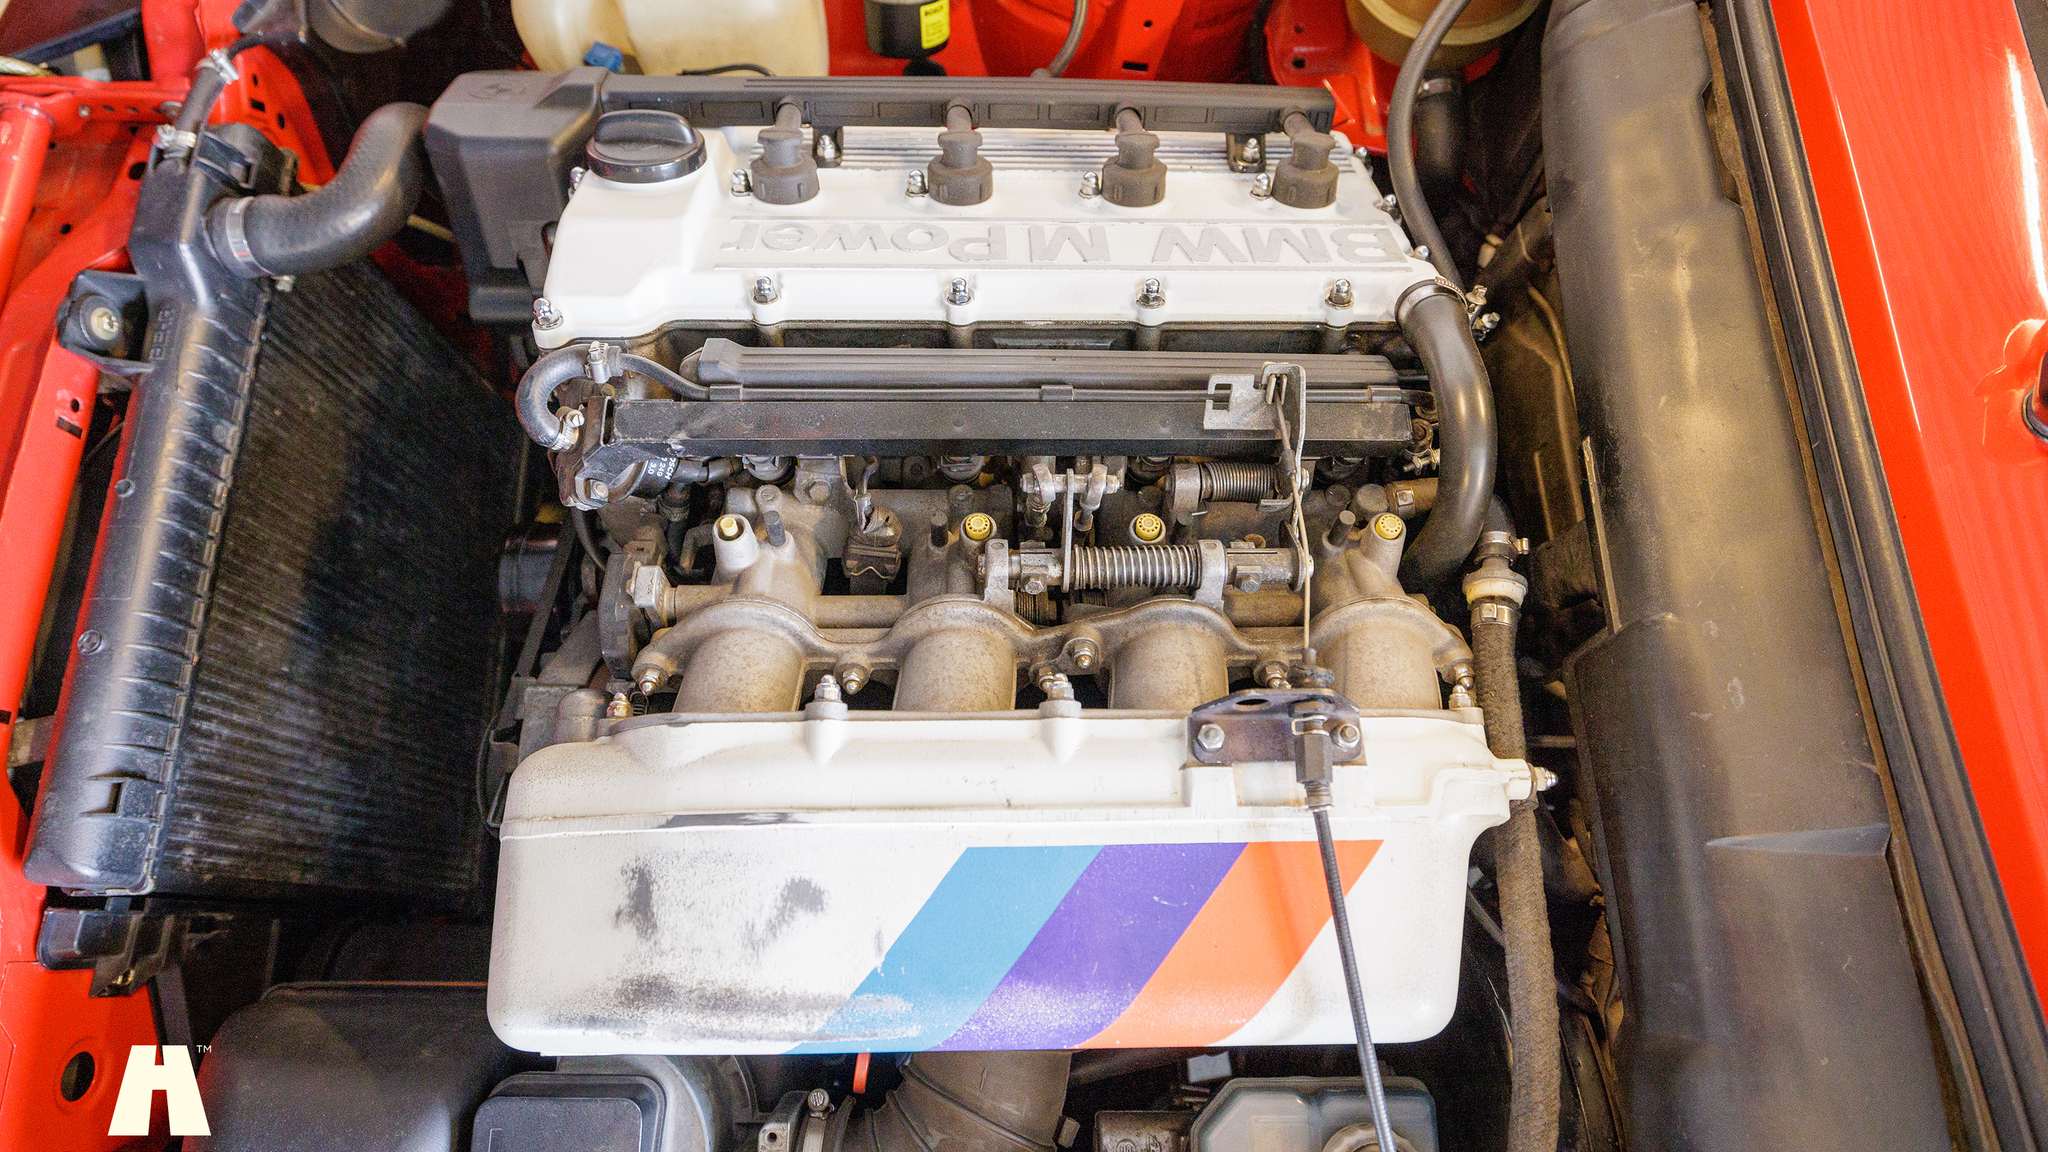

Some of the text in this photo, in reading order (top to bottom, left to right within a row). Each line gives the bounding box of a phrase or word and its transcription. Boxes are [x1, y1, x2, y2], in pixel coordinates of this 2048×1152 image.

[719, 223, 1408, 264] BMW M Power
